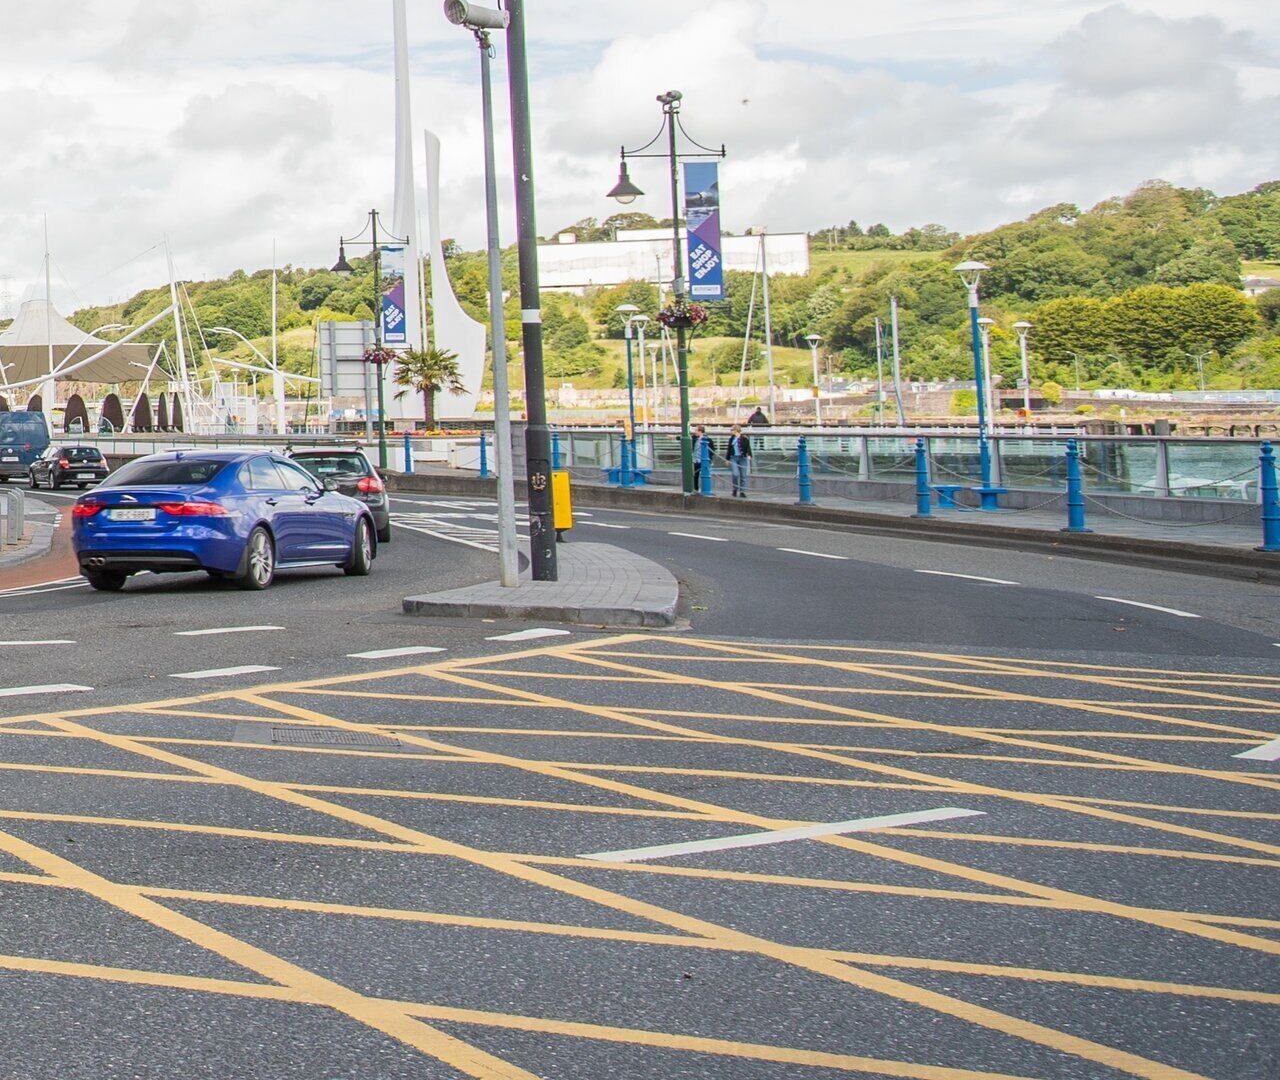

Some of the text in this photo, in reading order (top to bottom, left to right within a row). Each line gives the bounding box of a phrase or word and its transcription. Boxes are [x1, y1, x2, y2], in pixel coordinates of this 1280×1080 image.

[690, 244, 706, 260] EAT
[692, 250, 712, 270] SHOP
[694, 255, 719, 279] ENJOY
